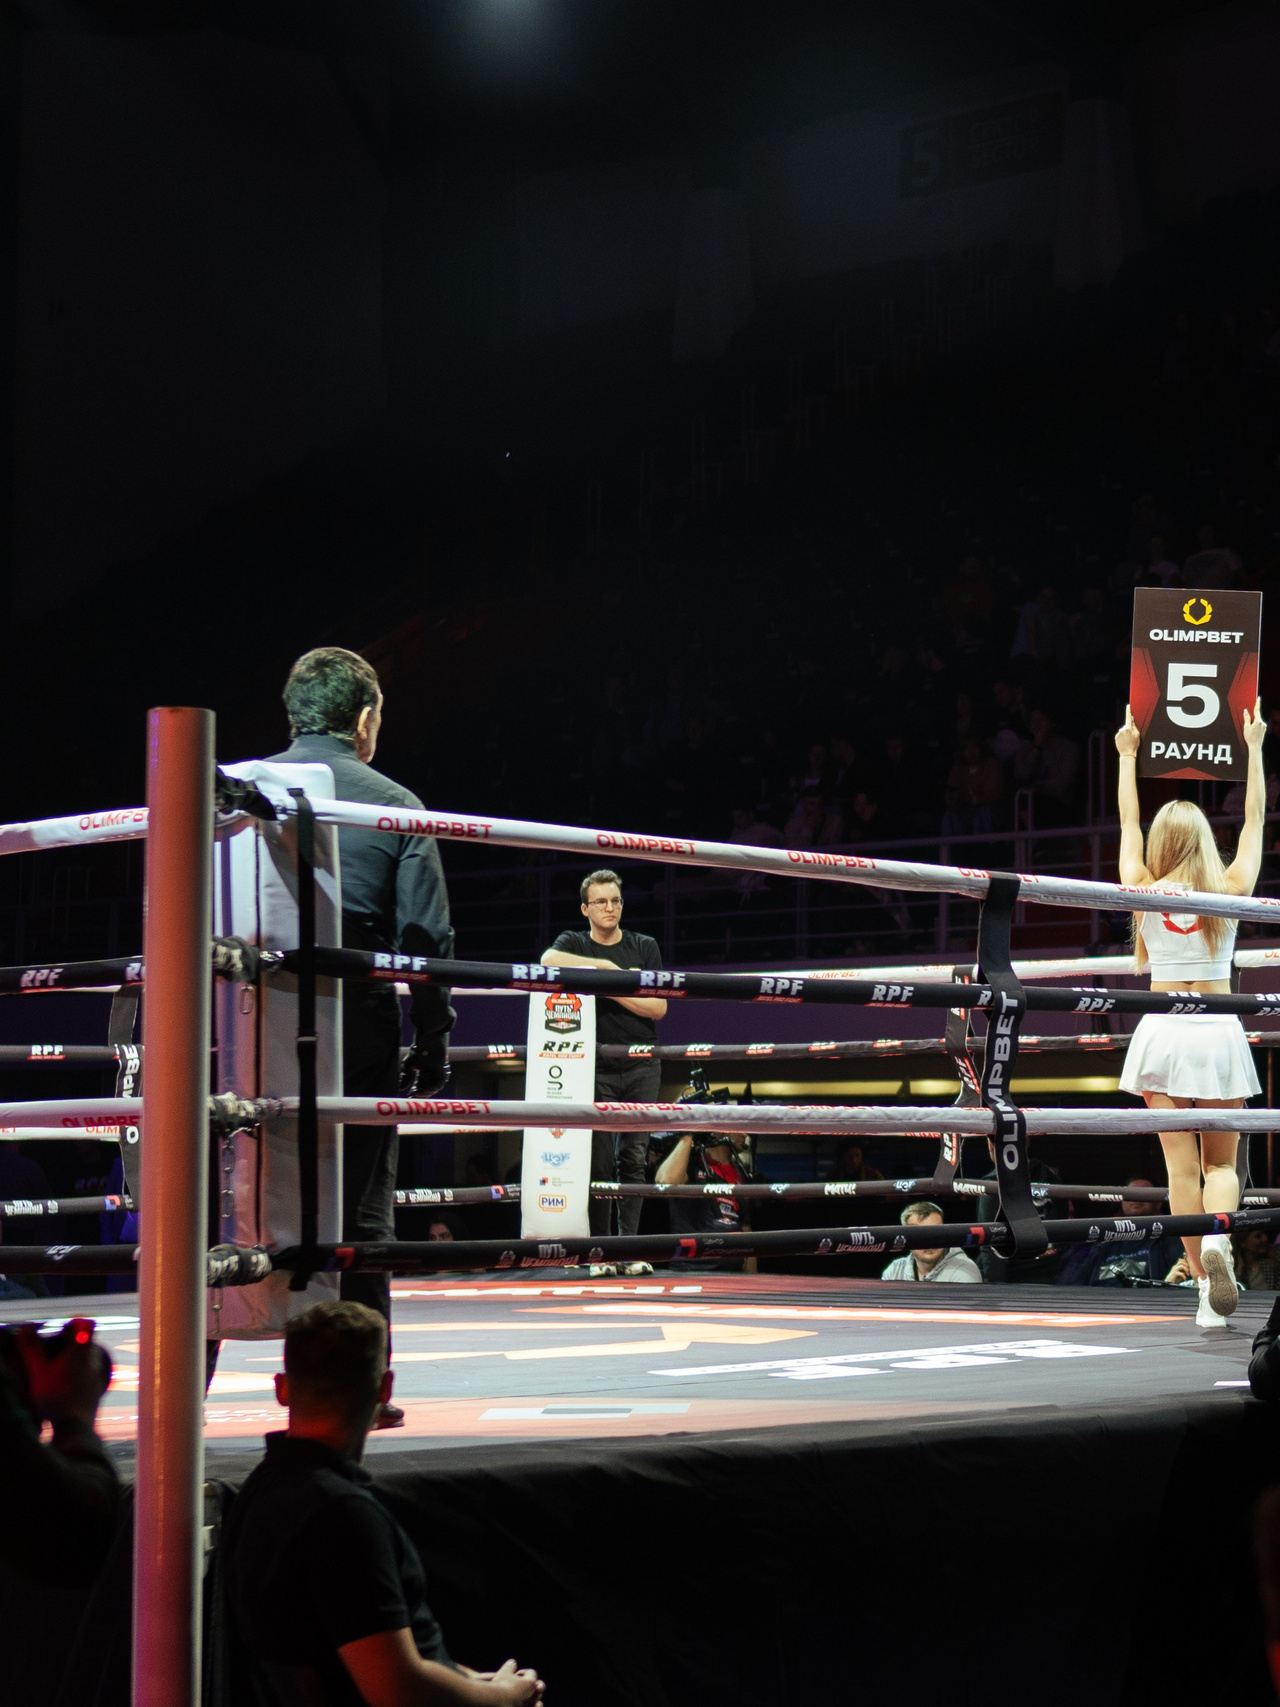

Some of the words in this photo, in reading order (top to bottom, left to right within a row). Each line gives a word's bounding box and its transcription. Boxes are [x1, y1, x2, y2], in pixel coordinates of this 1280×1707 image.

[1149, 628, 1244, 644] OLIMPBET
[1166, 662, 1220, 729] 5
[1150, 741, 1233, 765] РАУНД
[377, 816, 493, 839] OLIMPBET
[596, 833, 696, 856] OLIMPBET
[787, 850, 878, 870] OLIMPBET
[374, 952, 428, 971] RPF
[21, 968, 64, 987] RPF
[512, 964, 561, 981] RPF
[640, 971, 686, 988] RPF
[760, 978, 804, 996] RPF
[871, 984, 914, 1002] RPF
[1075, 997, 1116, 1012] RPF
[1168, 1002, 1207, 1014] RPF
[31, 1044, 63, 1055] RPF
[542, 1040, 584, 1052] RPF
[988, 990, 1019, 1171] OLIMPBET
[376, 1100, 492, 1116] OLIMPBET
[541, 1197, 564, 1207] РИМ
[1114, 1219, 1136, 1232] ПУТЬ
[850, 1231, 875, 1245] ПУТЬ
[538, 1243, 567, 1258] ПУТЬ
